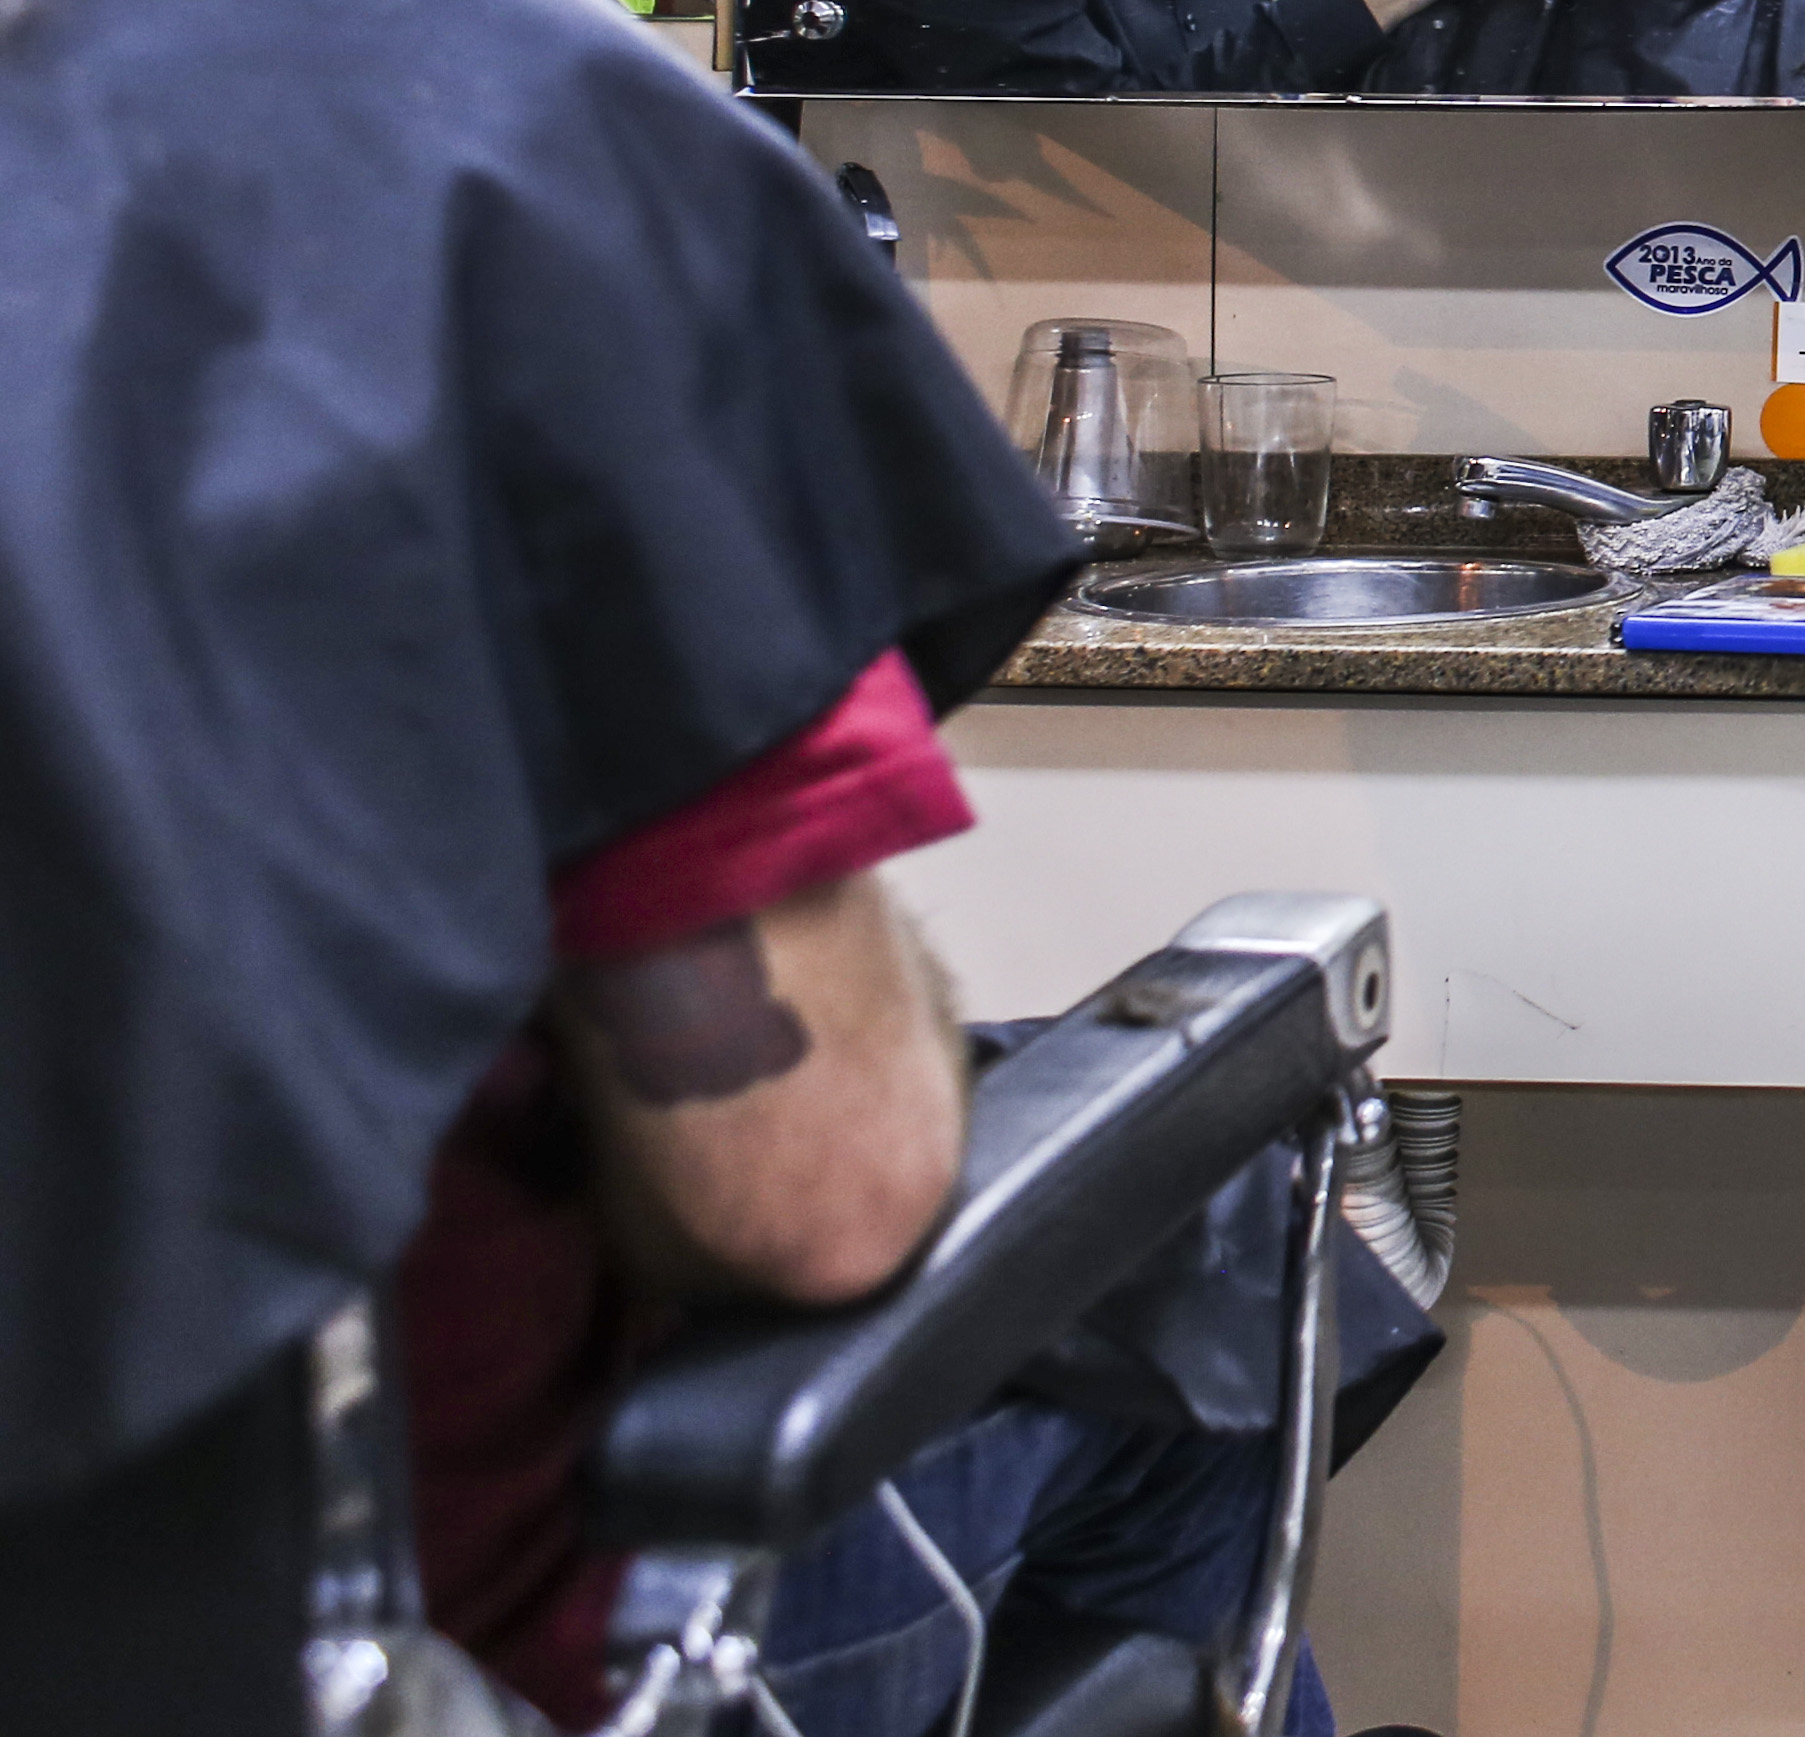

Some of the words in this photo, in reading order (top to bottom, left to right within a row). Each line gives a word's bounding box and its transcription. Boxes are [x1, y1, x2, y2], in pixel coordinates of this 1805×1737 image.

[1638, 244, 1696, 265] 2013
[1696, 256, 1716, 266] Ano
[1718, 256, 1732, 266] da
[1650, 265, 1736, 287] PESCA
[1656, 283, 1728, 296] maravilhosa
